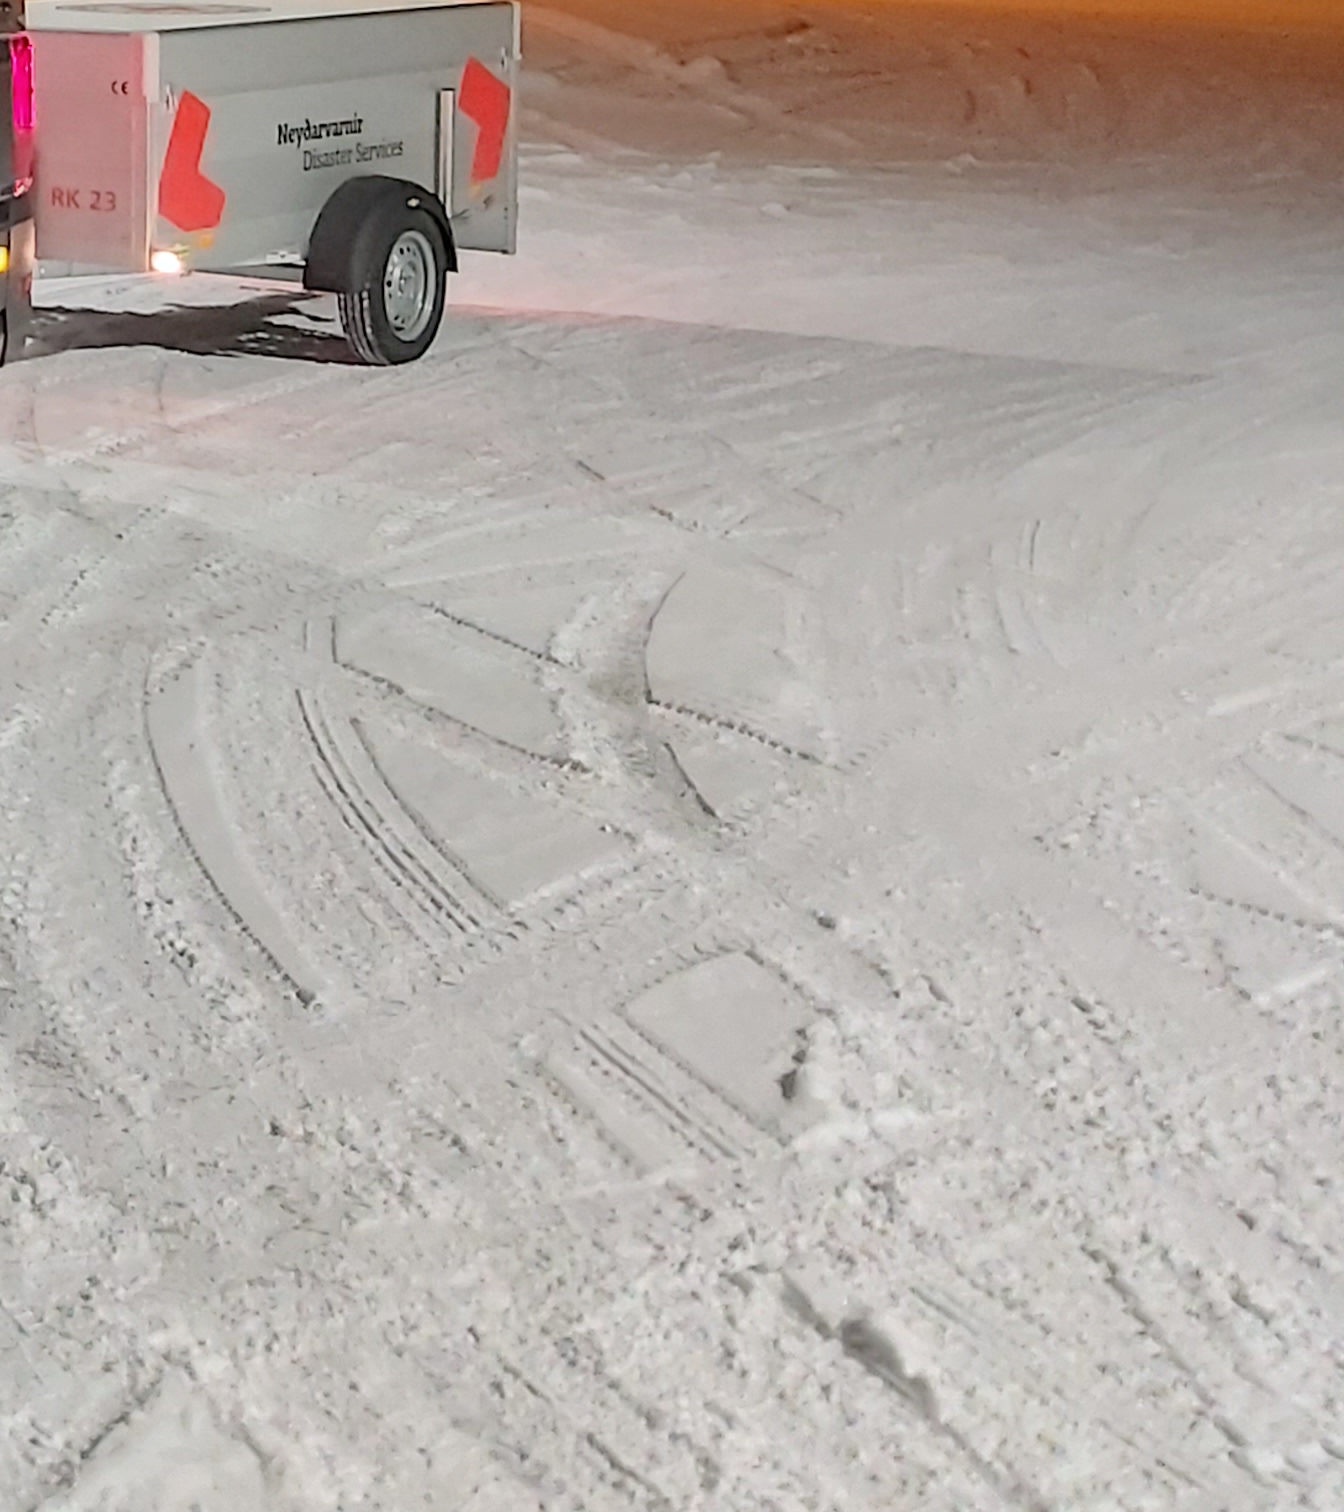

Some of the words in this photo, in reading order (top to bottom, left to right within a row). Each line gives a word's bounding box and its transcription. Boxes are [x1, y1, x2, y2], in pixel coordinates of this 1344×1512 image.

[303, 147, 353, 171] Disaster
[355, 138, 404, 163] Services
[52, 188, 80, 208] RK
[90, 190, 116, 211] 23
